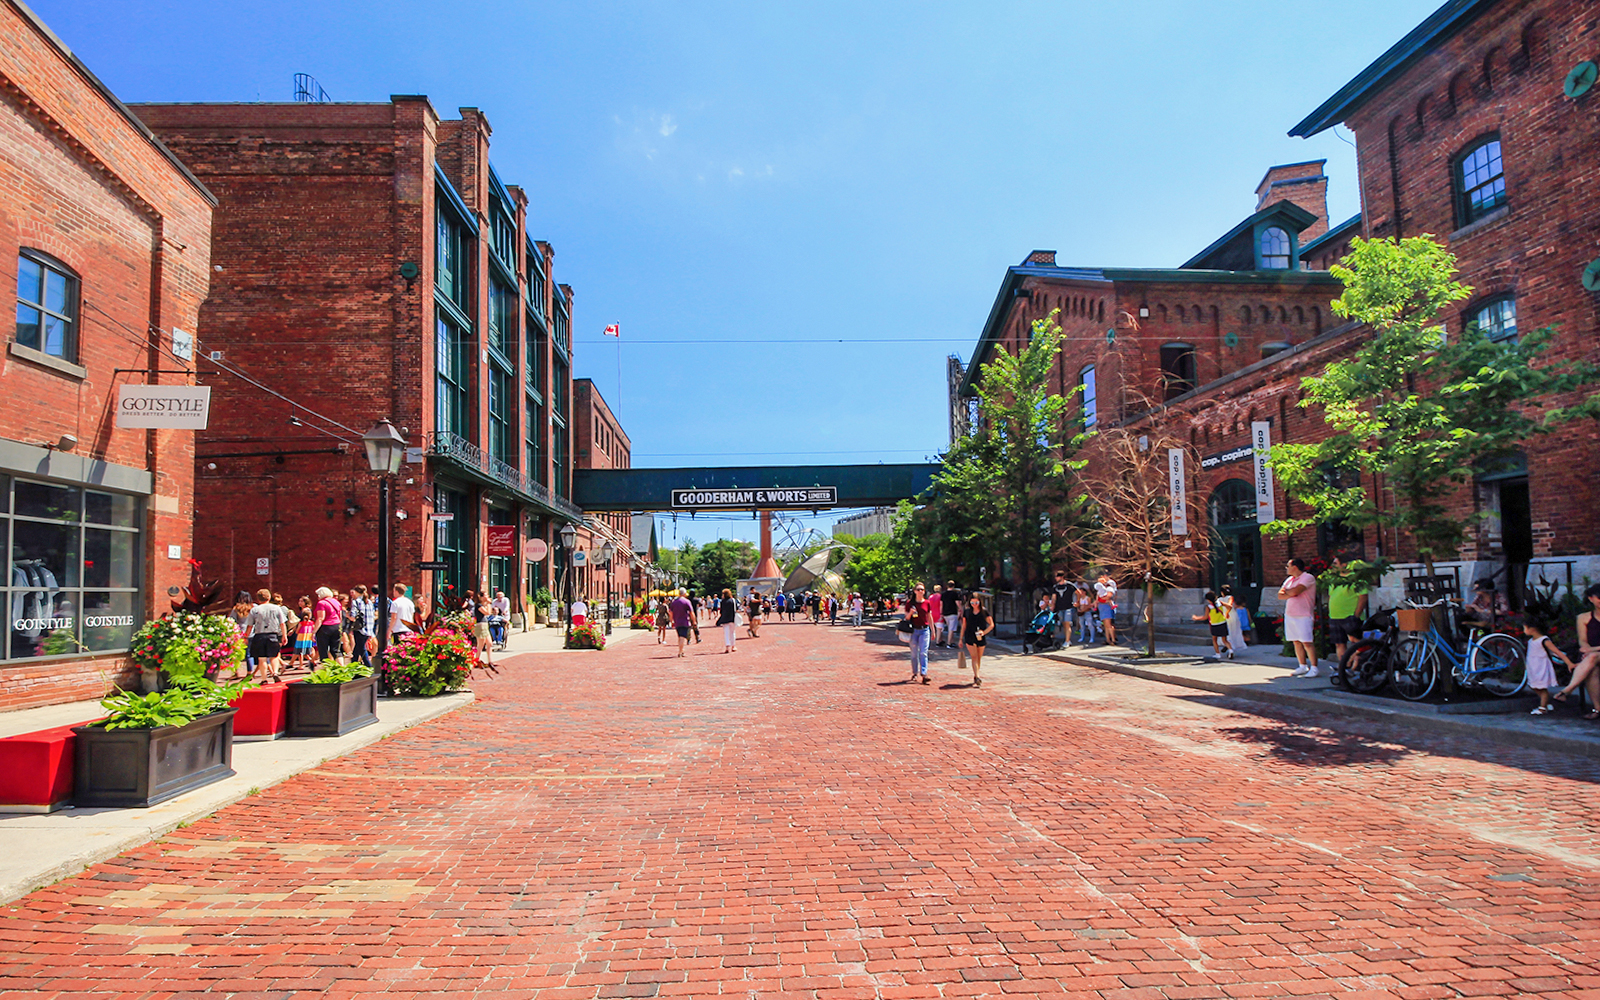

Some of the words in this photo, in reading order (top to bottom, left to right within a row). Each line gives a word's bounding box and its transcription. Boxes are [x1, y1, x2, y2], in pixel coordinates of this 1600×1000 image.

[122, 397, 203, 411] GOTSTYLE
[1201, 456, 1221, 468] cop.
[1221, 447, 1254, 462] copine
[679, 491, 754, 504] GOODERHAM
[756, 491, 766, 502] &
[766, 490, 807, 502] WORTS
[808, 492, 831, 500] LIMITED
[15, 617, 73, 631] GOTSTYLE
[85, 615, 134, 628] GOTSTYLE
